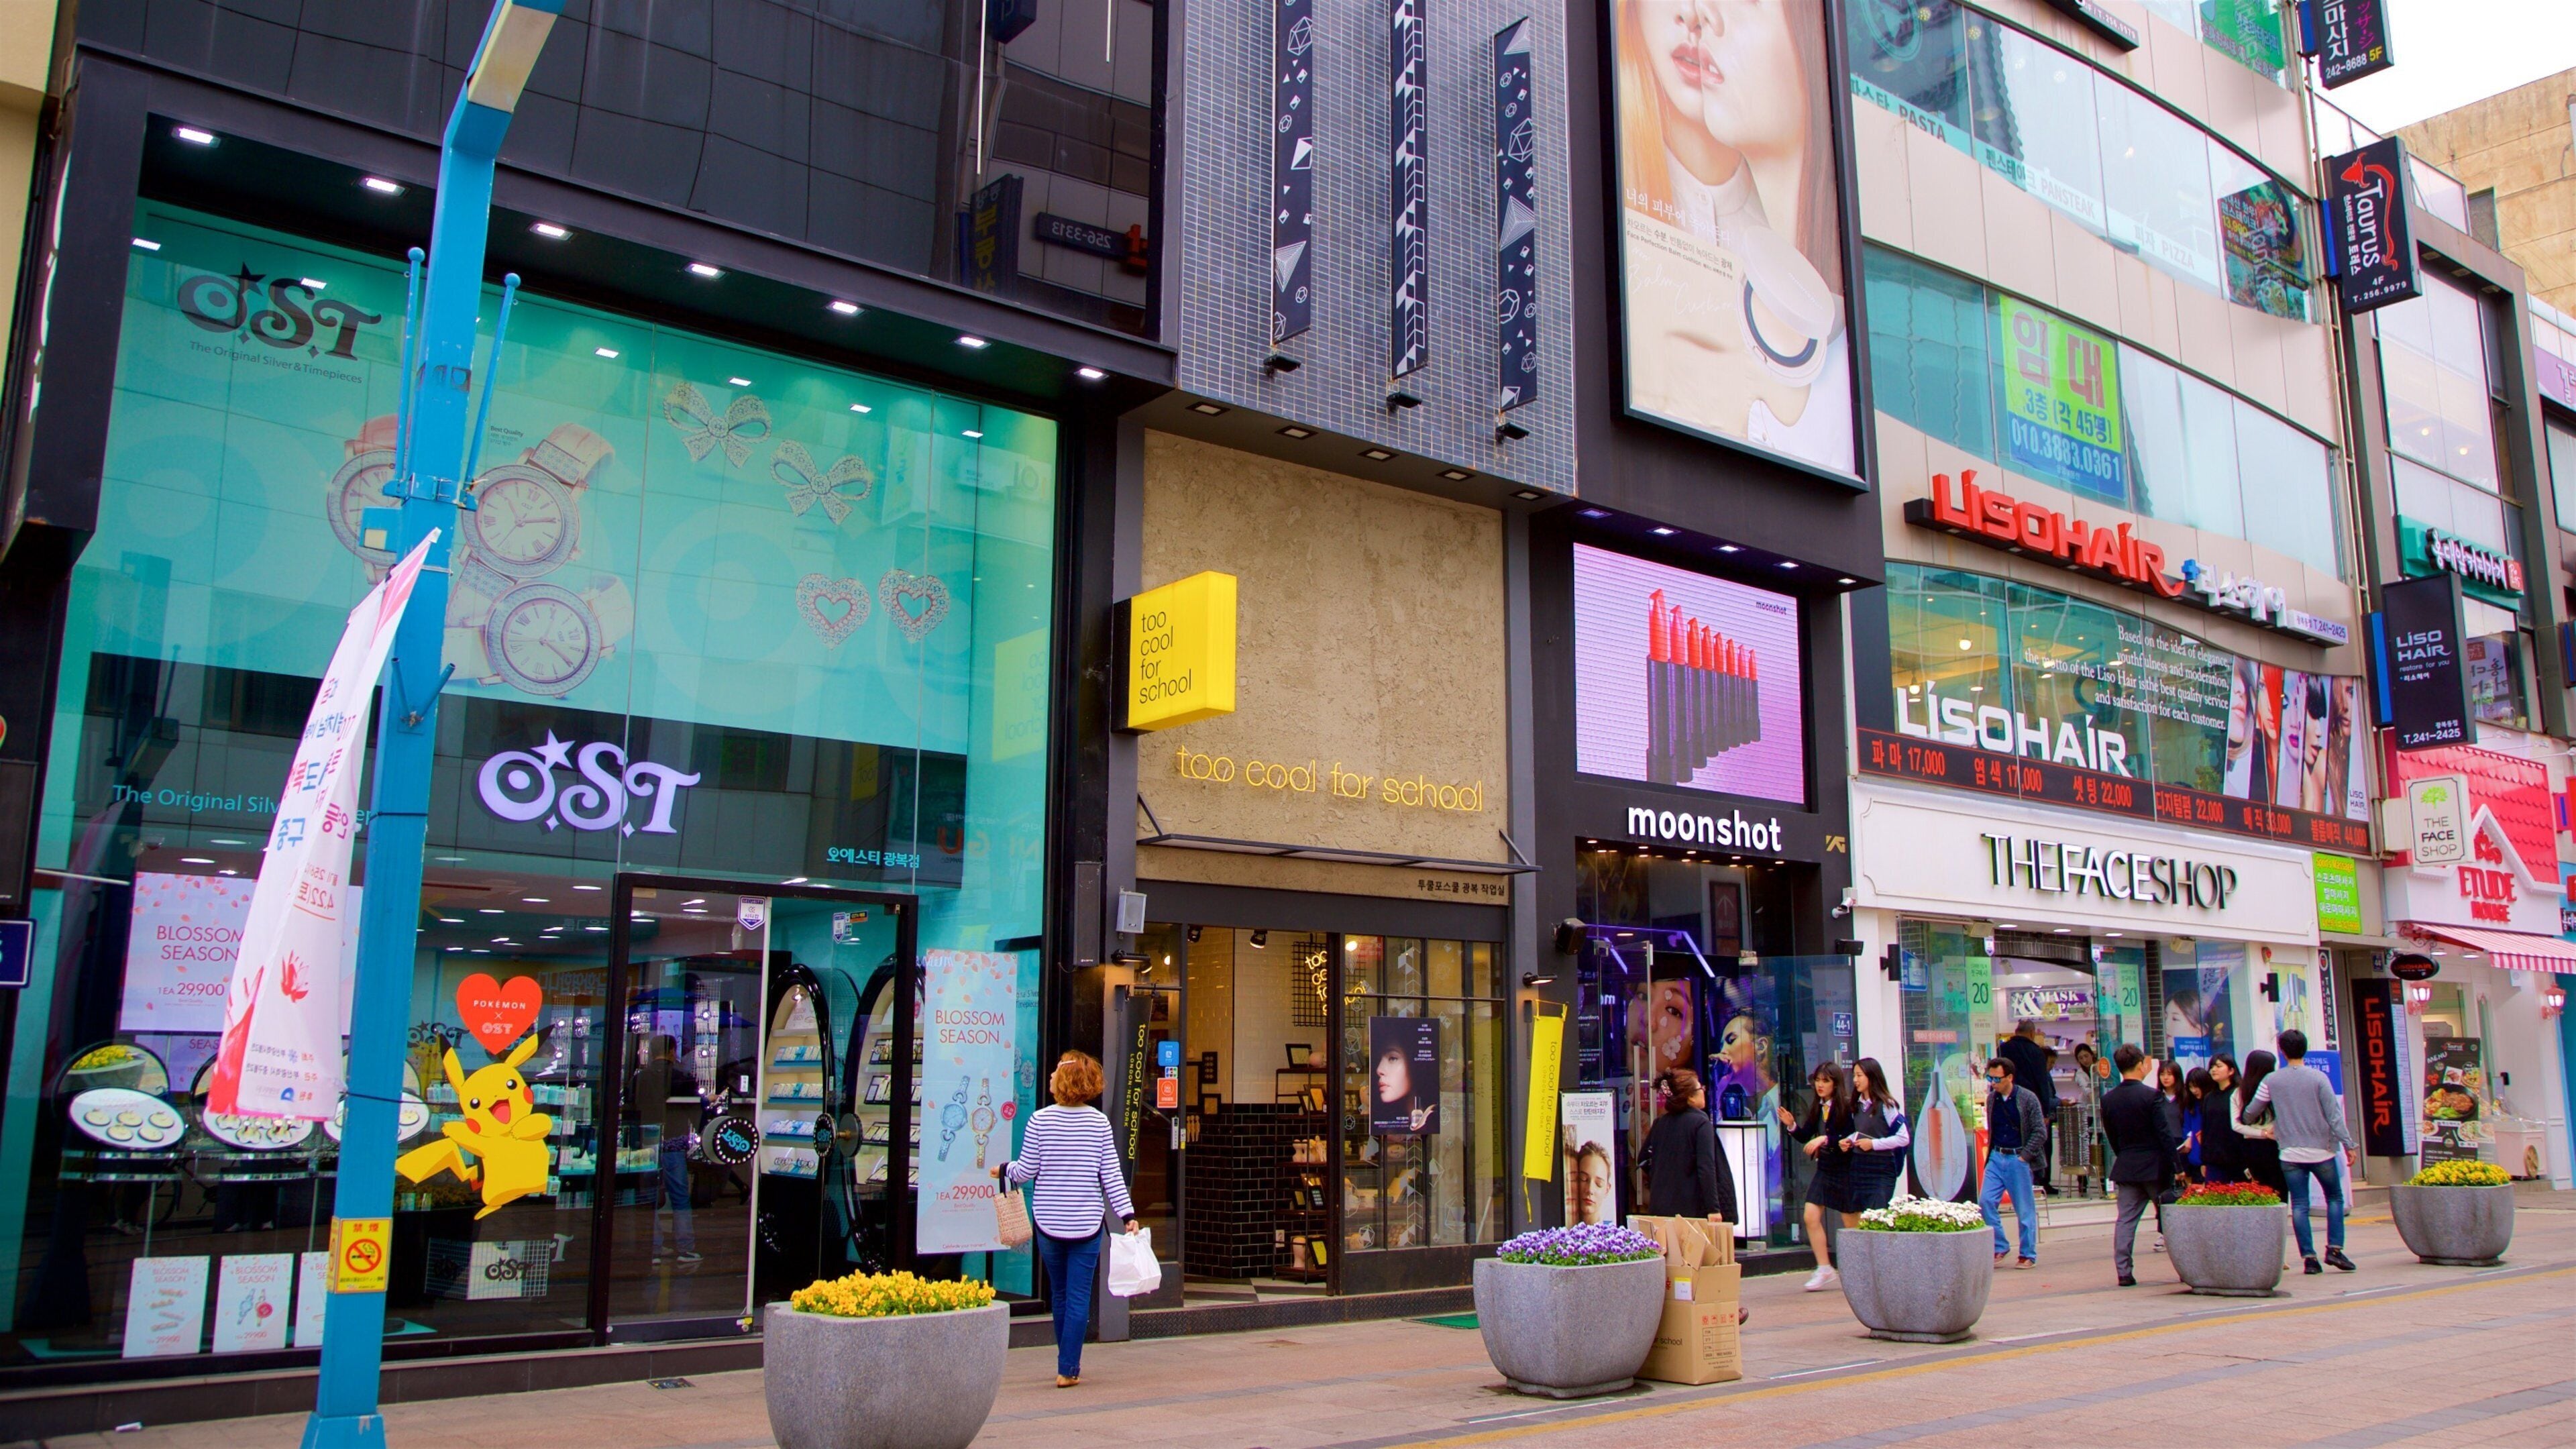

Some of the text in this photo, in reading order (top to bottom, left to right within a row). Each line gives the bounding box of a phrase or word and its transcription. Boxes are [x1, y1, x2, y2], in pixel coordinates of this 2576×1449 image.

[2326, 46, 2382, 79] 242-8688 5F
[1899, 105, 1946, 143] PASTA
[1626, 188, 1685, 227] 너의 피부에
[2041, 178, 2094, 219] PANSTEAK
[2355, 178, 2383, 268] Taurus
[1627, 230, 1640, 240] Face
[1641, 235, 1668, 252] Perfection
[2134, 225, 2194, 270] 피자 PIZZA
[2353, 280, 2407, 303] T.256.9979
[2371, 276, 2384, 286] 4F
[190, 341, 211, 354] The
[213, 345, 260, 364] Original
[2012, 417, 2121, 482] 010.3883.0361
[1756, 601, 1787, 616] moonshot
[1141, 611, 1166, 633] too
[1140, 625, 1173, 656] cool
[2118, 625, 2230, 669] Based on the idea of elegance,
[1140, 658, 1161, 680] for
[2116, 651, 2229, 691] youthfulness and moderation,
[2400, 663, 2423, 672] restore
[2438, 659, 2450, 668] you
[1139, 669, 1191, 704] school
[2025, 647, 2039, 665] the
[2070, 659, 2080, 675] of
[2081, 662, 2095, 678] the
[2097, 665, 2116, 682] Liso
[2118, 669, 2137, 688] Hair
[2139, 676, 2145, 689] is
[2146, 676, 2158, 692] the
[2160, 679, 2176, 696] best
[2178, 687, 2203, 707] quality
[2205, 695, 2229, 710] service
[2095, 690, 2226, 730] and satisfaction for each customer.
[2404, 728, 2461, 744] T.241-2425
[1177, 745, 1482, 811] too cool for school
[1908, 747, 1945, 776] 17,000
[2007, 764, 2042, 792] 17,000
[2101, 782, 2132, 808] 22,000
[2196, 798, 2224, 823] 22,000
[113, 785, 241, 812] The Original
[1627, 806, 1782, 852] moonshot
[2424, 816, 2449, 827] THE
[2421, 830, 2455, 843] FACE
[826, 847, 920, 869] 오에스티 광복점
[2422, 844, 2457, 857] SHOP
[1417, 879, 1505, 897] 투쿨포스쿨 광복 작업실
[2458, 865, 2517, 902] ETUDE
[156, 926, 246, 941] BLOSSOM
[160, 945, 239, 962] SEASON
[178, 983, 225, 997] 29,900
[1972, 983, 1988, 1004] 20
[2123, 987, 2137, 1006] 20
[474, 999, 526, 1009] POKÉMON
[2324, 977, 2334, 1035] TAURUS
[935, 1010, 1005, 1026] BLOSSOM
[1837, 1020, 1850, 1030] 44-1
[940, 1029, 1000, 1044] SEASON
[1138, 1024, 1146, 1047] too
[1550, 1041, 1558, 1061] too
[1548, 1064, 1556, 1093] cool
[1133, 1087, 1141, 1108] for
[1128, 1110, 1139, 1159] school
[1544, 1115, 1552, 1157] school
[952, 1185, 994, 1201] 29,900
[235, 1265, 277, 1274] BLOSSOM
[1661, 1337, 1683, 1346] school
